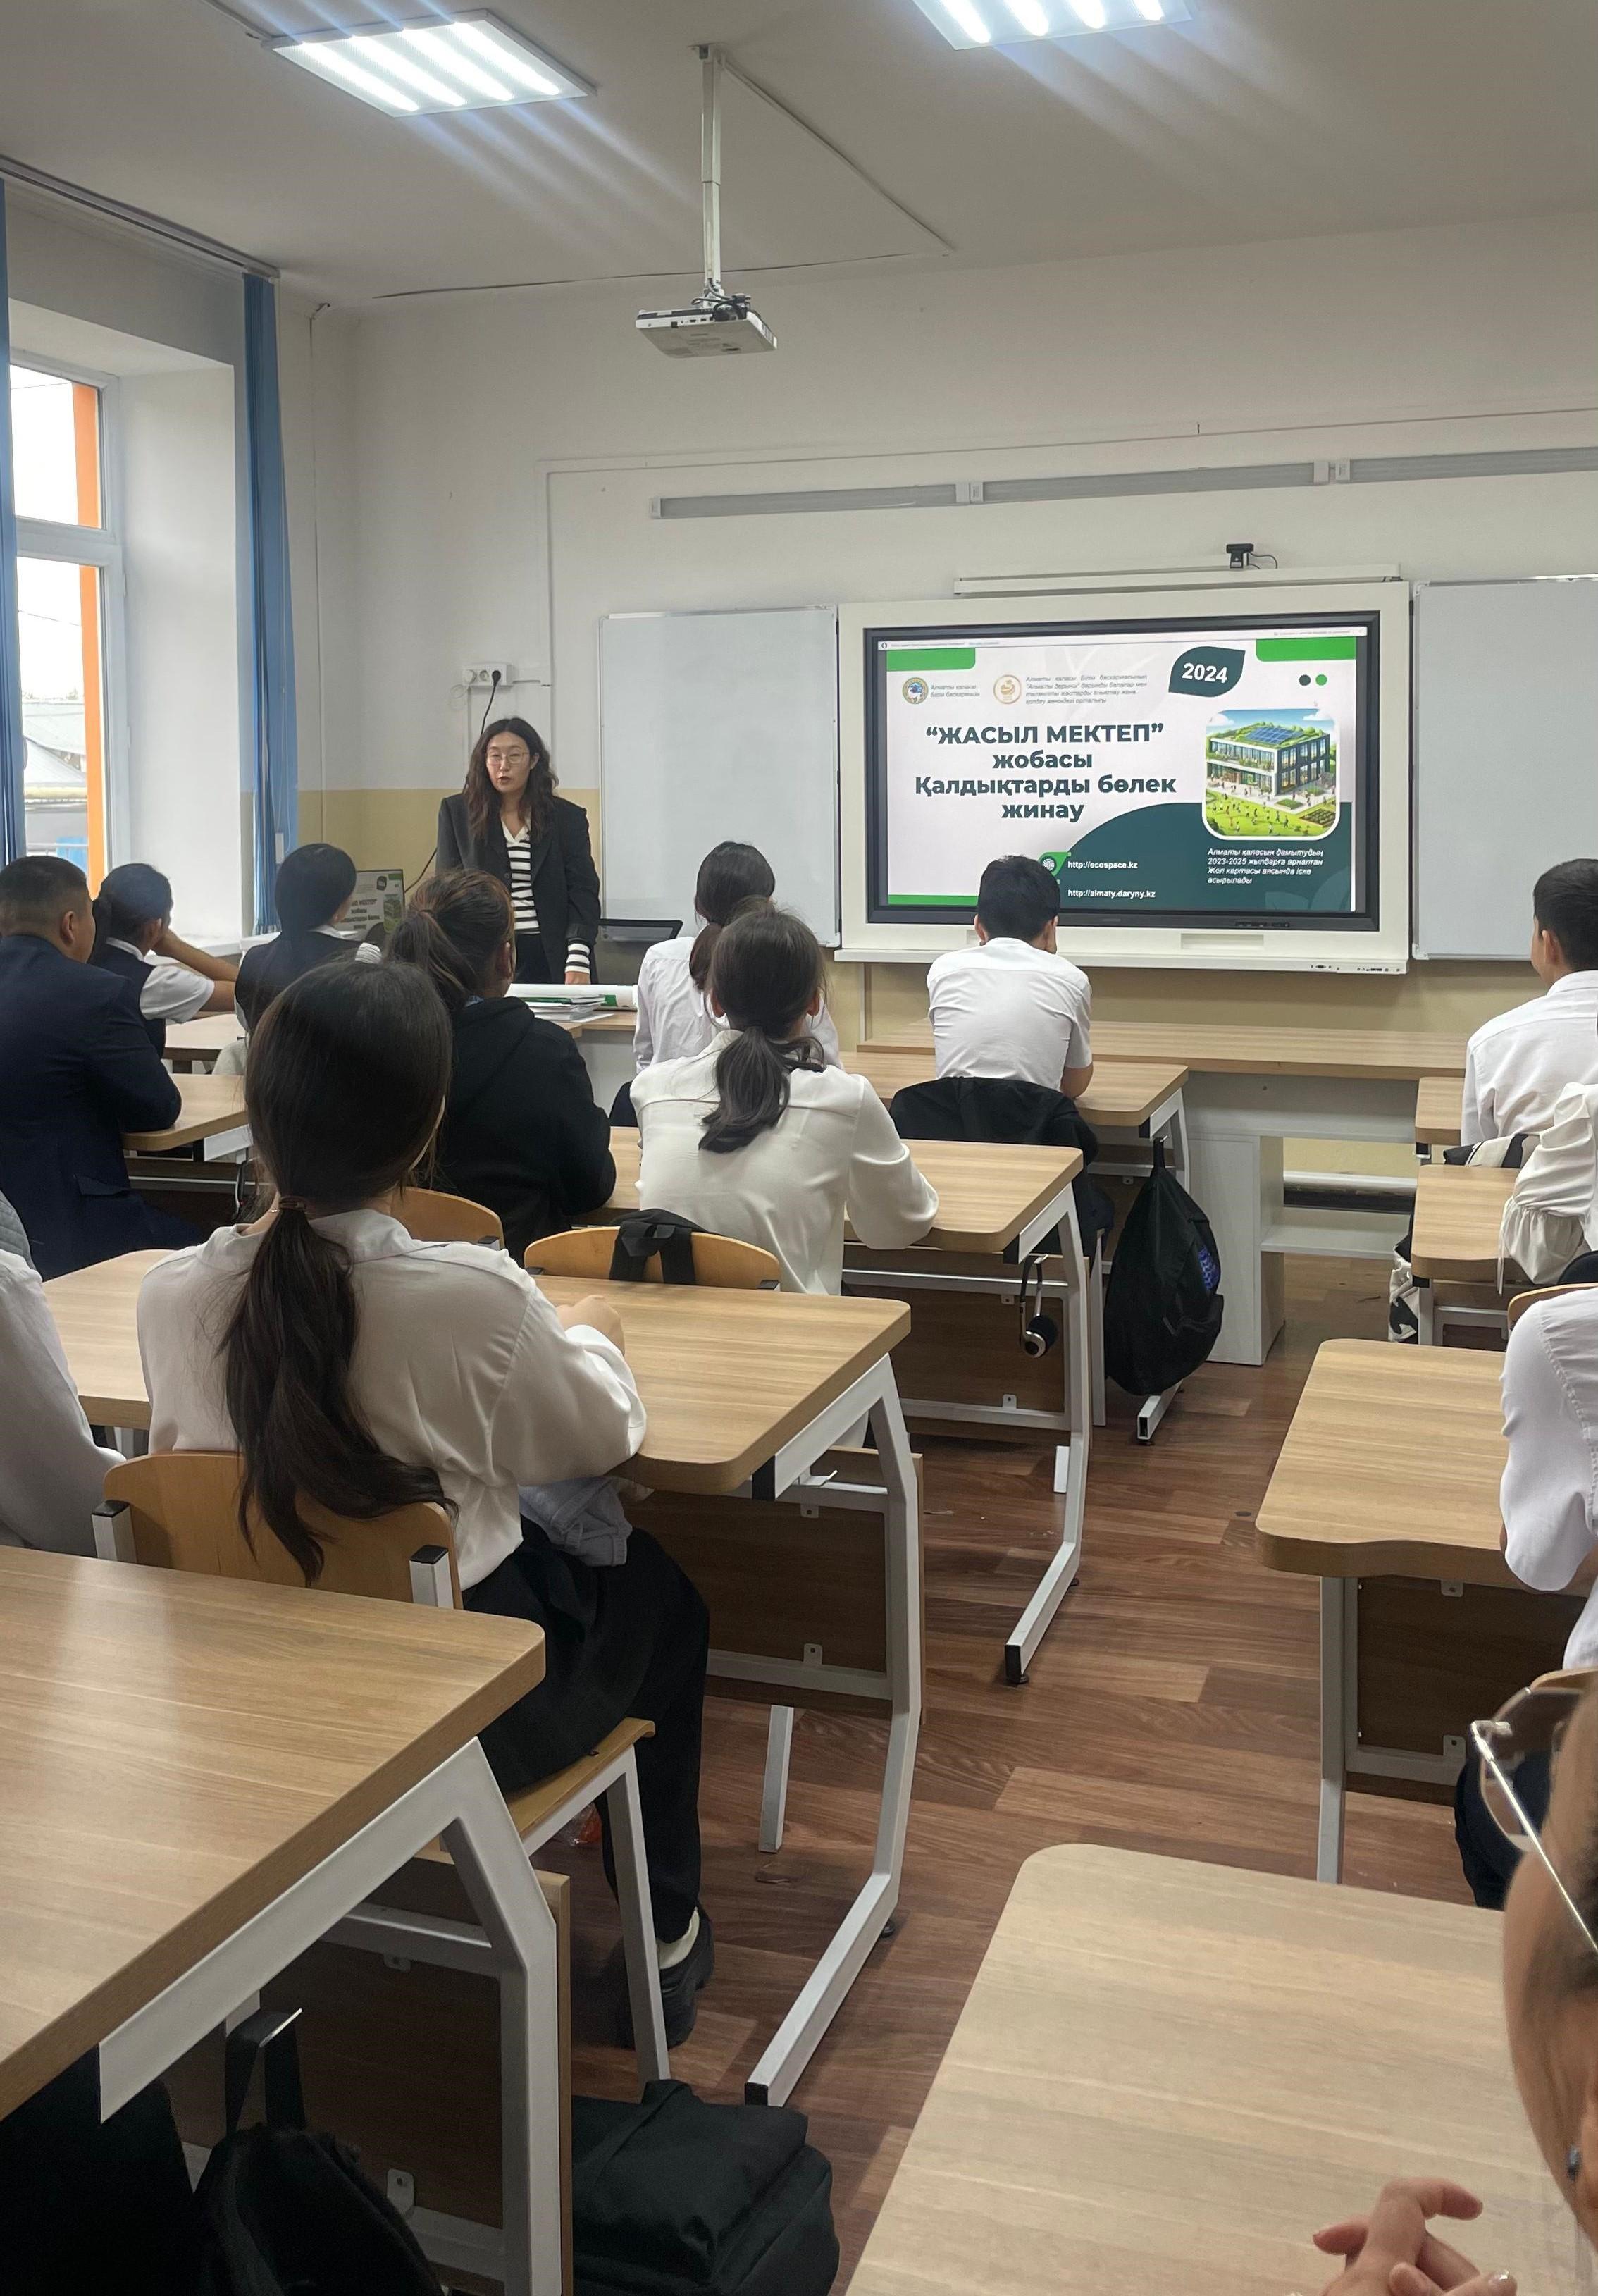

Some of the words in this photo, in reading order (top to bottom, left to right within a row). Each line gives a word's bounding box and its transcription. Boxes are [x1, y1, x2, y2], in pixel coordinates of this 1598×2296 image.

[1182, 662, 1228, 684] 2024
[926, 726, 1039, 744] “ЖАСЫЛ
[1046, 723, 1164, 743] МЕКТЕП”
[993, 750, 1093, 770] жобасы
[915, 777, 1090, 798] Қалдықтарды
[1098, 774, 1176, 794] бөлек
[1002, 801, 1084, 822] жинау
[1067, 861, 1139, 870] http://ecospace.kz
[1208, 857, 1246, 865] 2023-2025
[1208, 866, 1225, 875] Жол
[1208, 876, 1252, 885] асырылады
[1067, 889, 1156, 899] http://almaty.daryny.kz
